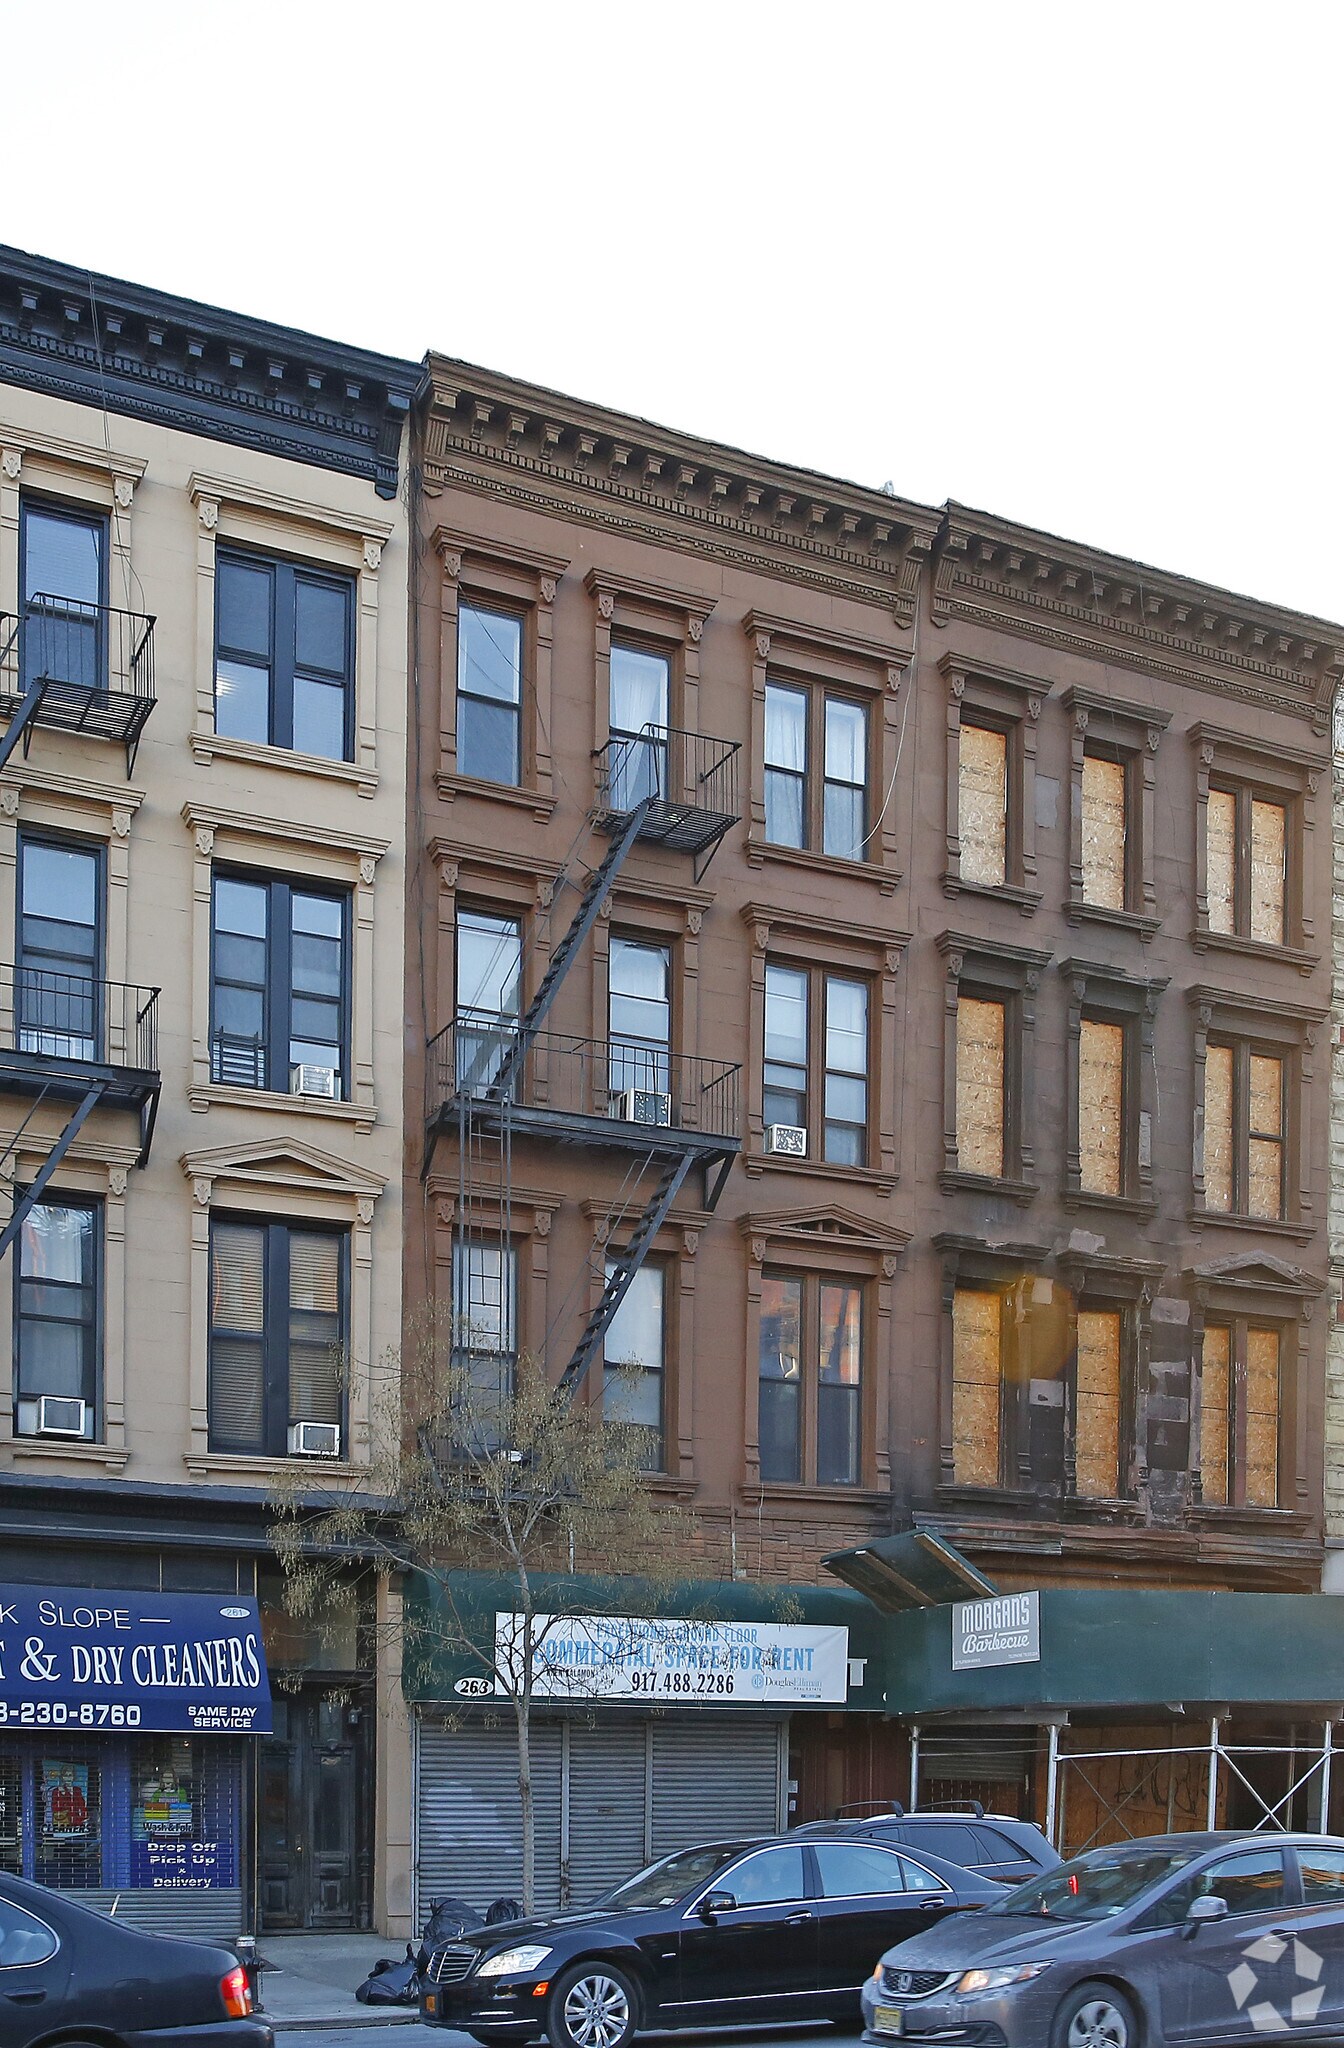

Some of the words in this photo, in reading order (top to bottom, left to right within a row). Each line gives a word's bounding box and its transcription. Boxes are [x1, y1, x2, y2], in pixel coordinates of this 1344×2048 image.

[38, 1600, 131, 1629] SLOPE
[225, 1607, 244, 1617] 261
[724, 1628, 758, 1643] FLOOR
[962, 1632, 1030, 1654] Barbecue
[19, 1636, 61, 1682] &
[71, 1645, 125, 1685] DRY
[131, 1634, 261, 1688] CLEANERS
[664, 1645, 720, 1670] SPACE
[730, 1646, 762, 1671] FOR
[772, 1648, 815, 1672] RENT
[460, 1680, 489, 1694] 263
[631, 1672, 735, 1695] 917.488.2286
[188, 1706, 228, 1718] SAME
[231, 1707, 258, 1718] DAY
[193, 1717, 252, 1728] SERVICE
[147, 1843, 187, 1853] Drop
[191, 1842, 217, 1853] Off
[150, 1855, 186, 1864] Pick
[192, 1855, 215, 1866] Up
[153, 1877, 212, 1889] Delivery
